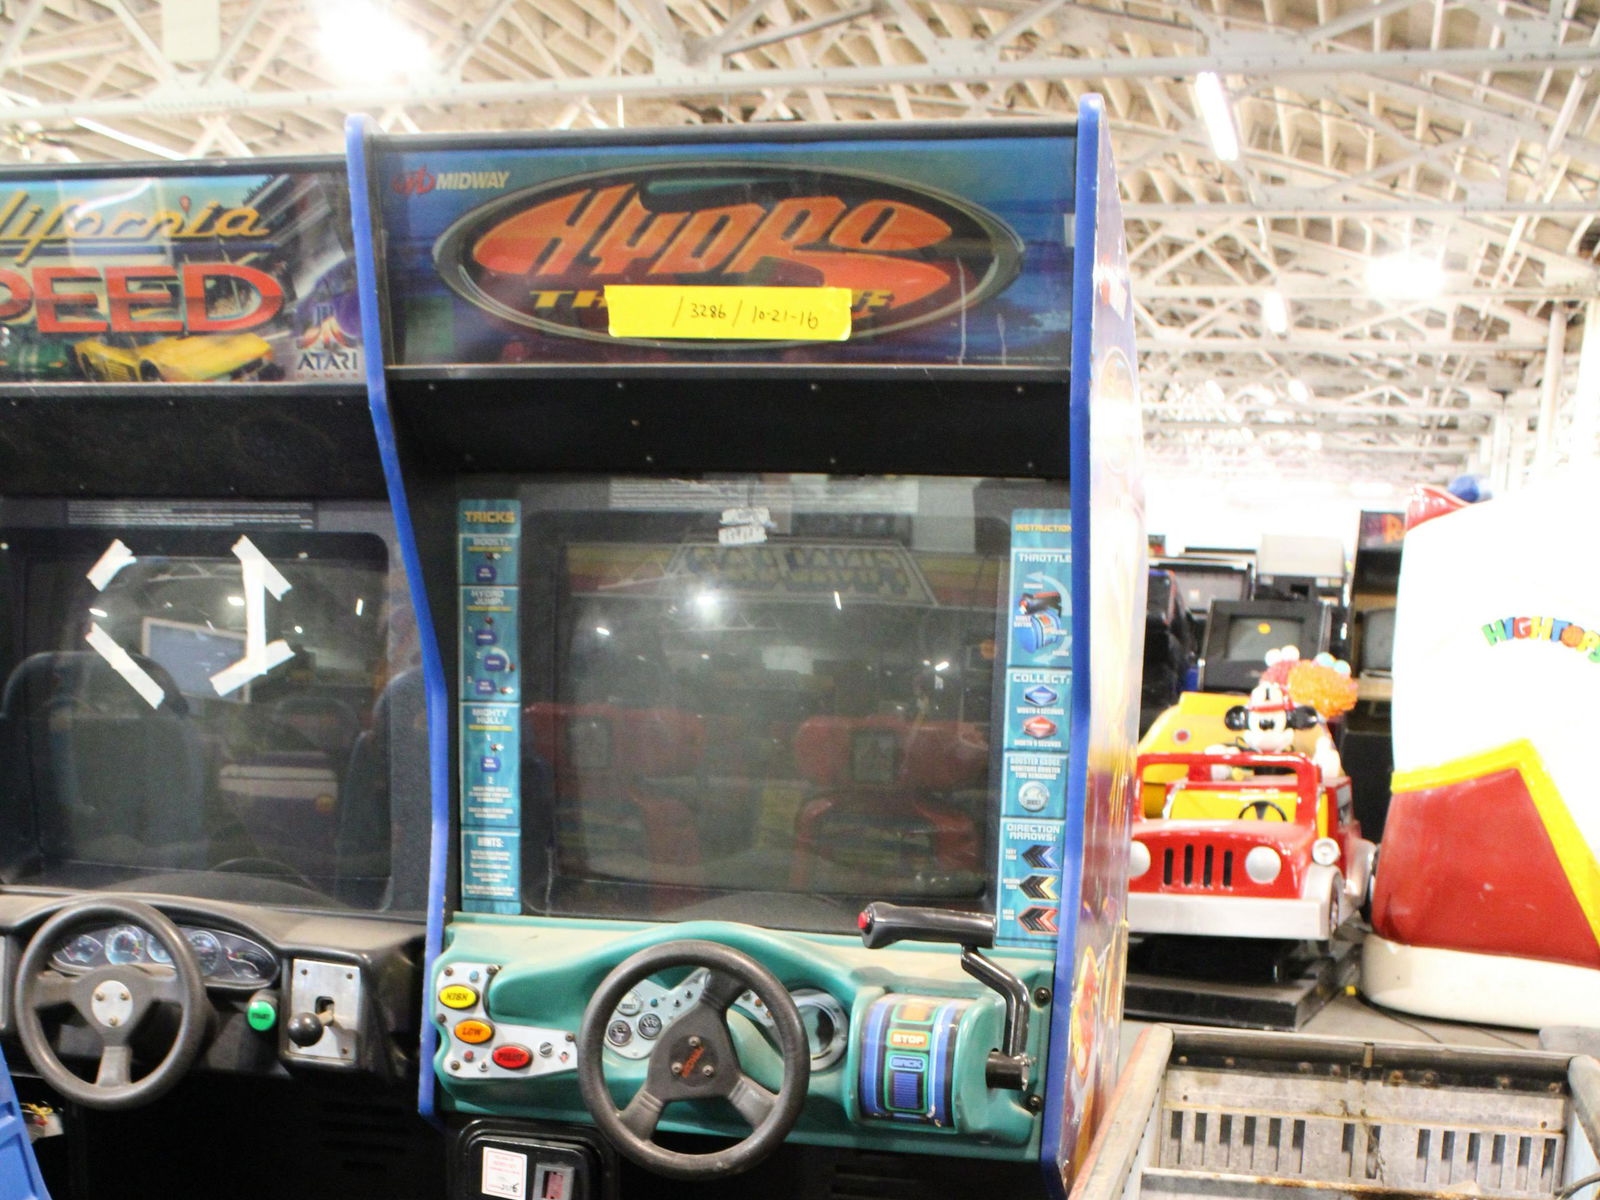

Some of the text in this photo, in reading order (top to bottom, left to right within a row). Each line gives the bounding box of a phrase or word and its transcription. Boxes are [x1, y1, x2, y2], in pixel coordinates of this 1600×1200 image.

[436, 171, 510, 190] MIDWAY
[298, 351, 358, 370] ATARI
[465, 511, 516, 524] TRICKS
[1006, 823, 1060, 834] DIRECTION
